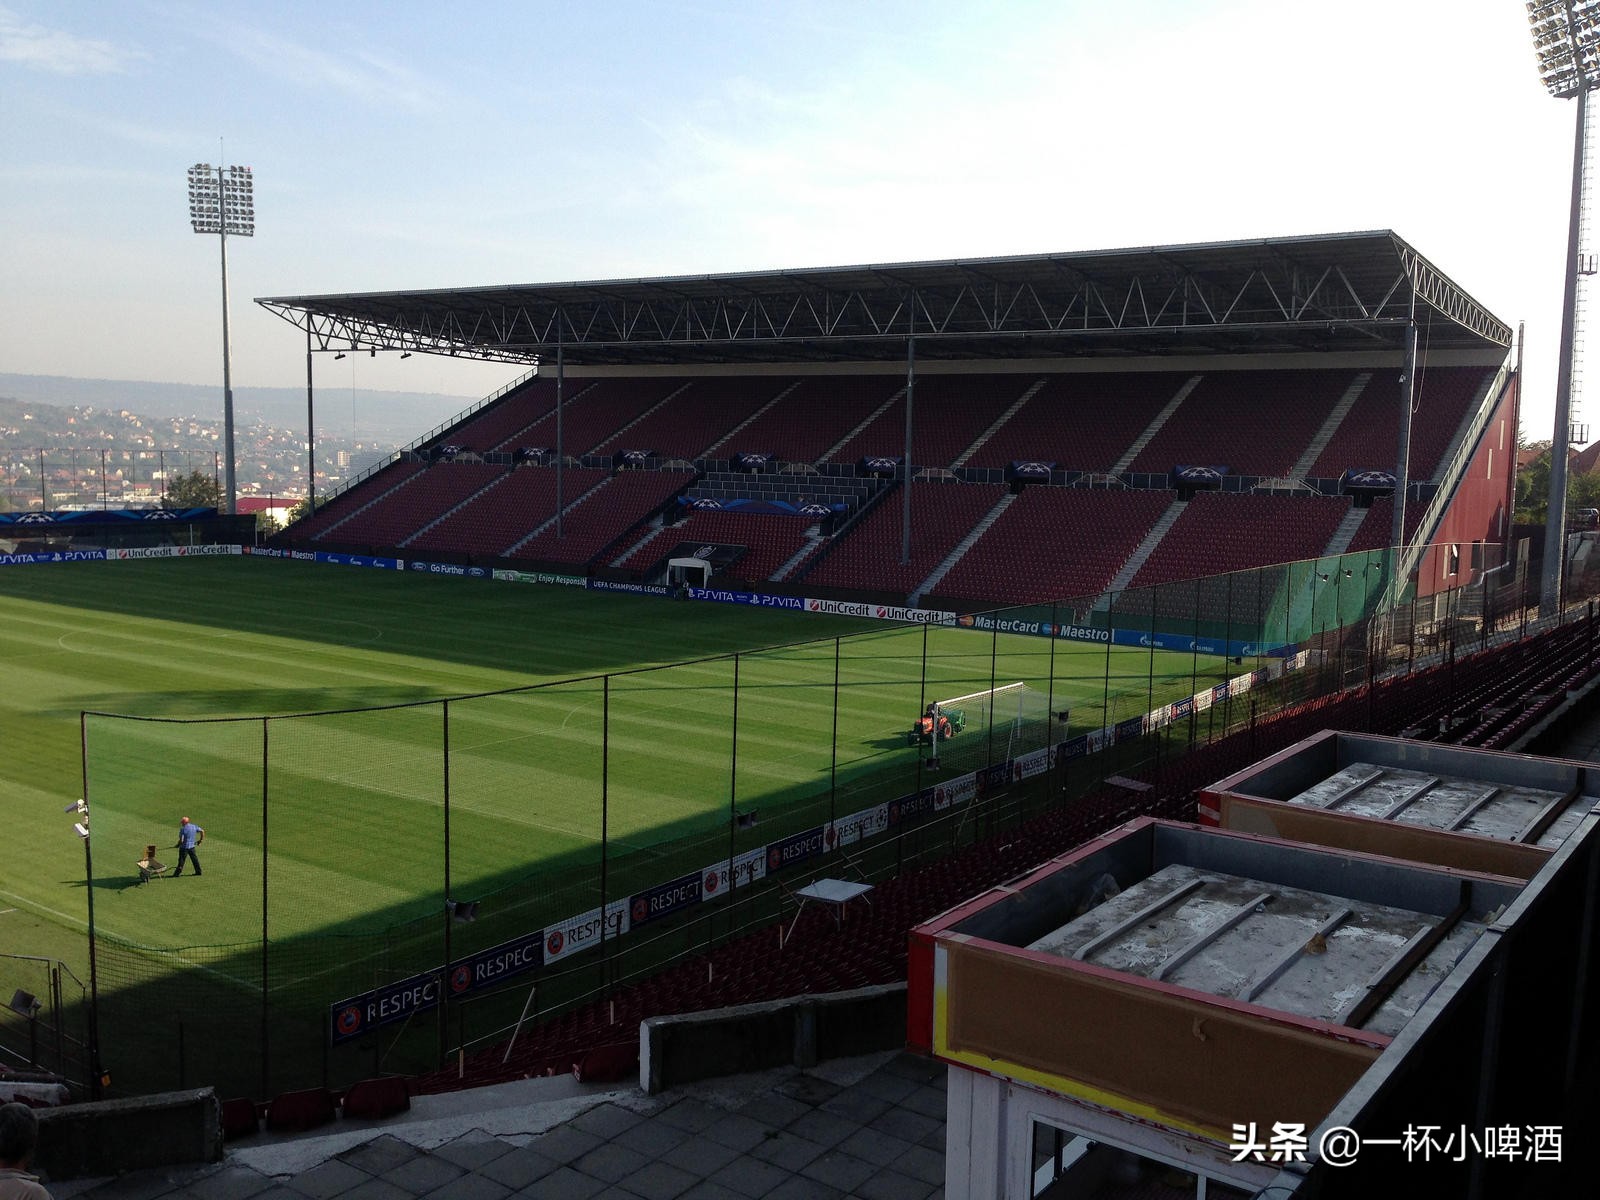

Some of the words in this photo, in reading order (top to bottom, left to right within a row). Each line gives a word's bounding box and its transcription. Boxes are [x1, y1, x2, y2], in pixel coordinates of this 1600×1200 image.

[128, 548, 172, 558] UniCredit
[187, 546, 229, 555] UniCredit
[291, 550, 314, 560] Maestro
[430, 564, 440, 572] Go
[441, 565, 464, 575] Further
[538, 574, 555, 583] Enjoy
[609, 583, 642, 592] CHAMPIONS
[644, 586, 667, 594] LEAGUE
[820, 601, 869, 616] UniCredit
[887, 607, 940, 622] UniCredit
[974, 616, 1039, 634] MasterCard
[1060, 624, 1109, 641] Maestro
[783, 834, 822, 861] RESPECT
